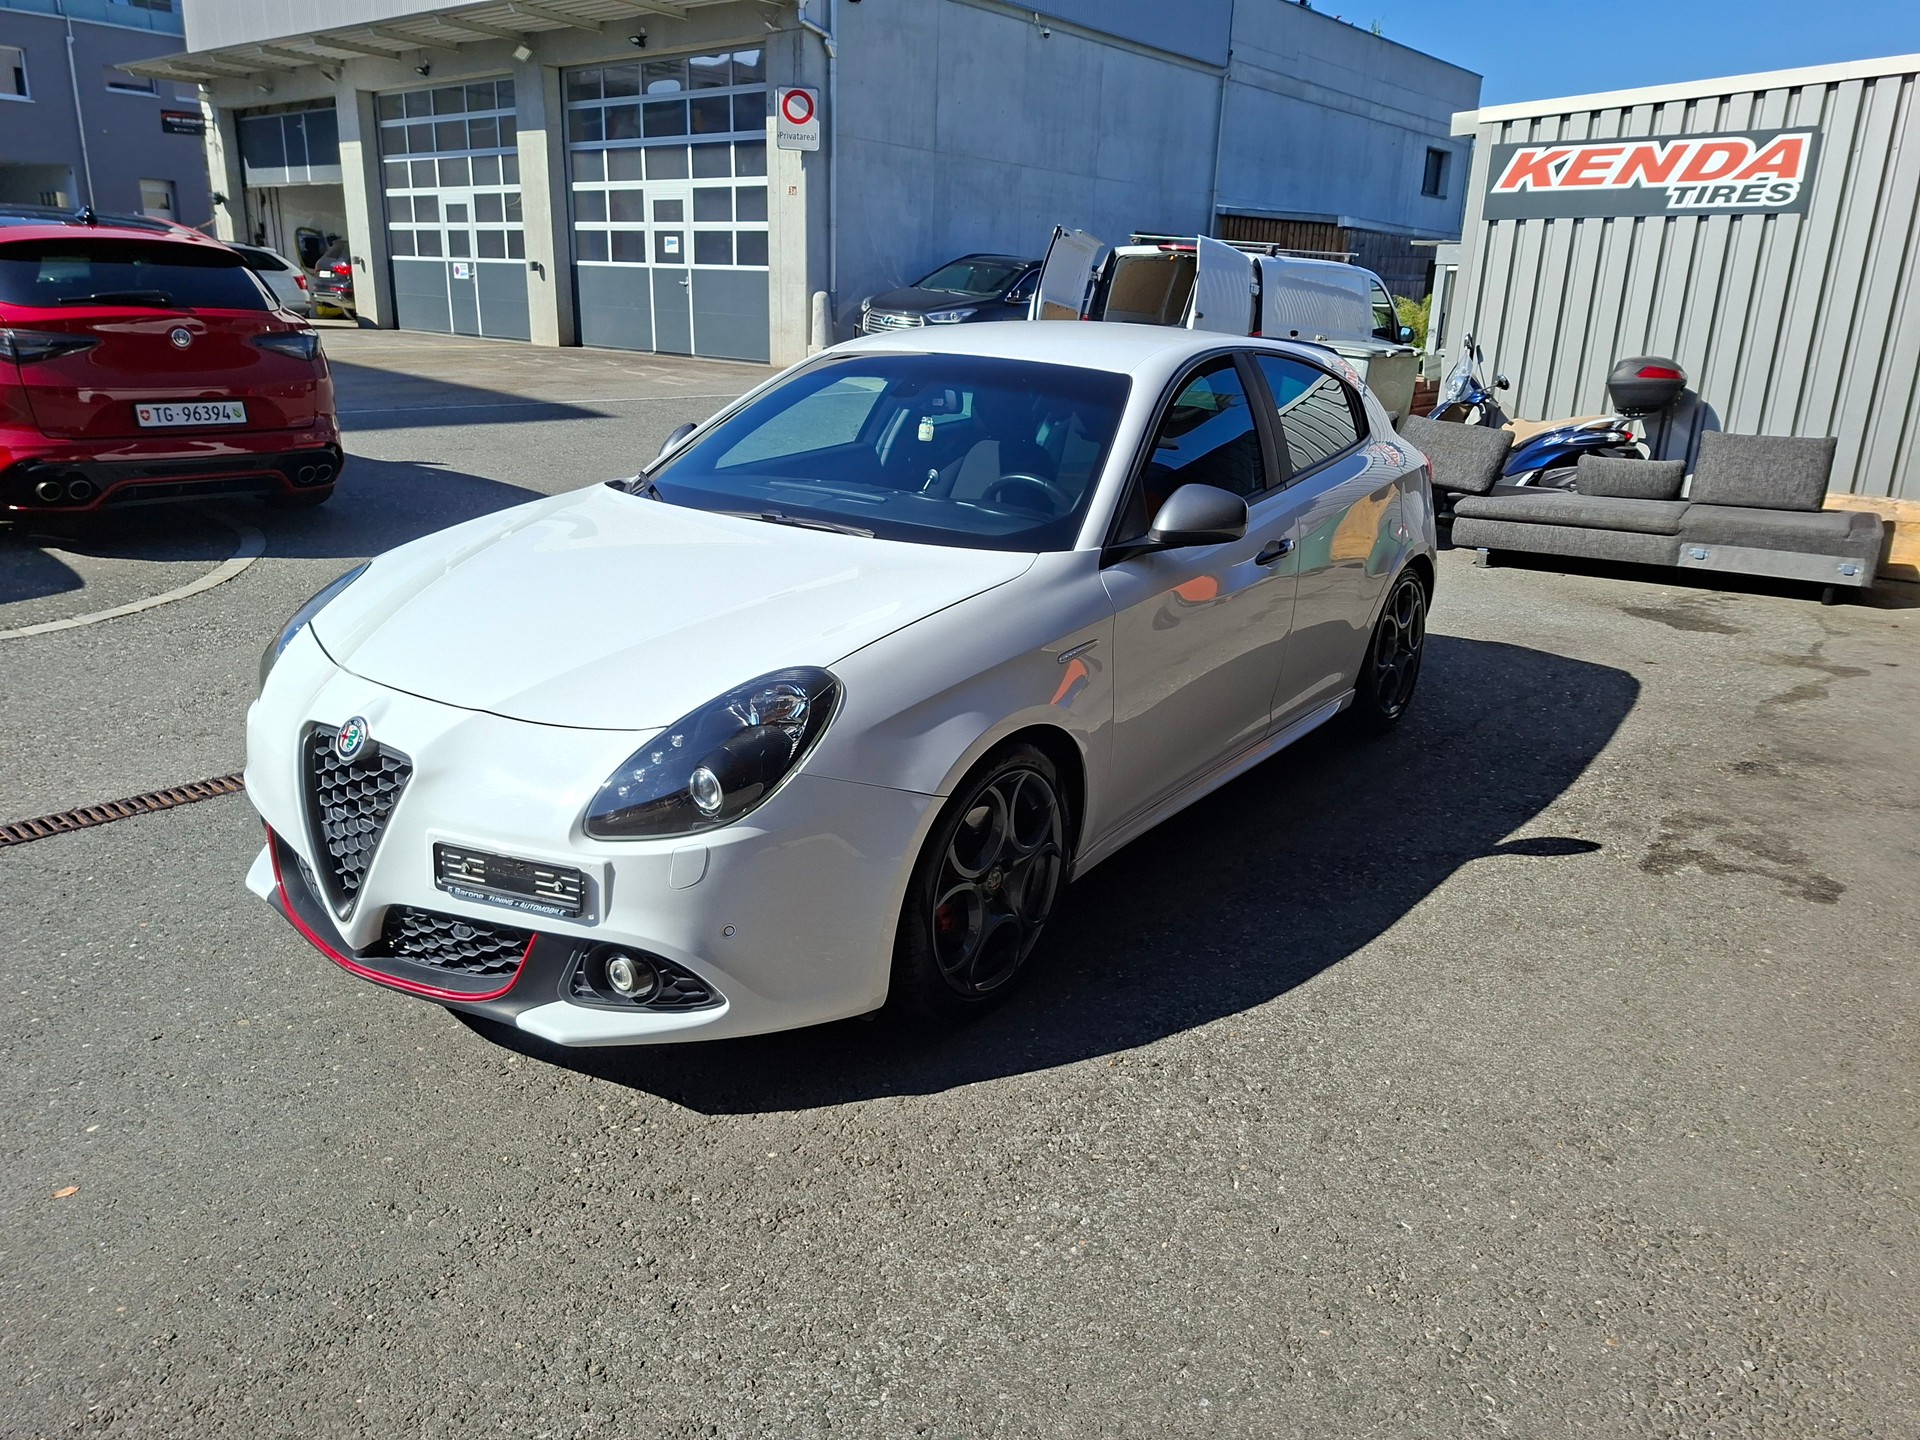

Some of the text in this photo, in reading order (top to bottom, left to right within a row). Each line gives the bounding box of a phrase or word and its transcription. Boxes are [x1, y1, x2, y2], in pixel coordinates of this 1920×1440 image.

[779, 131, 817, 141] Privatareal
[1497, 137, 1806, 189] KENDA
[1669, 181, 1796, 206] TIRES
[488, 895, 515, 906] TUNING
[519, 902, 566, 917] AUTOMOBILE
